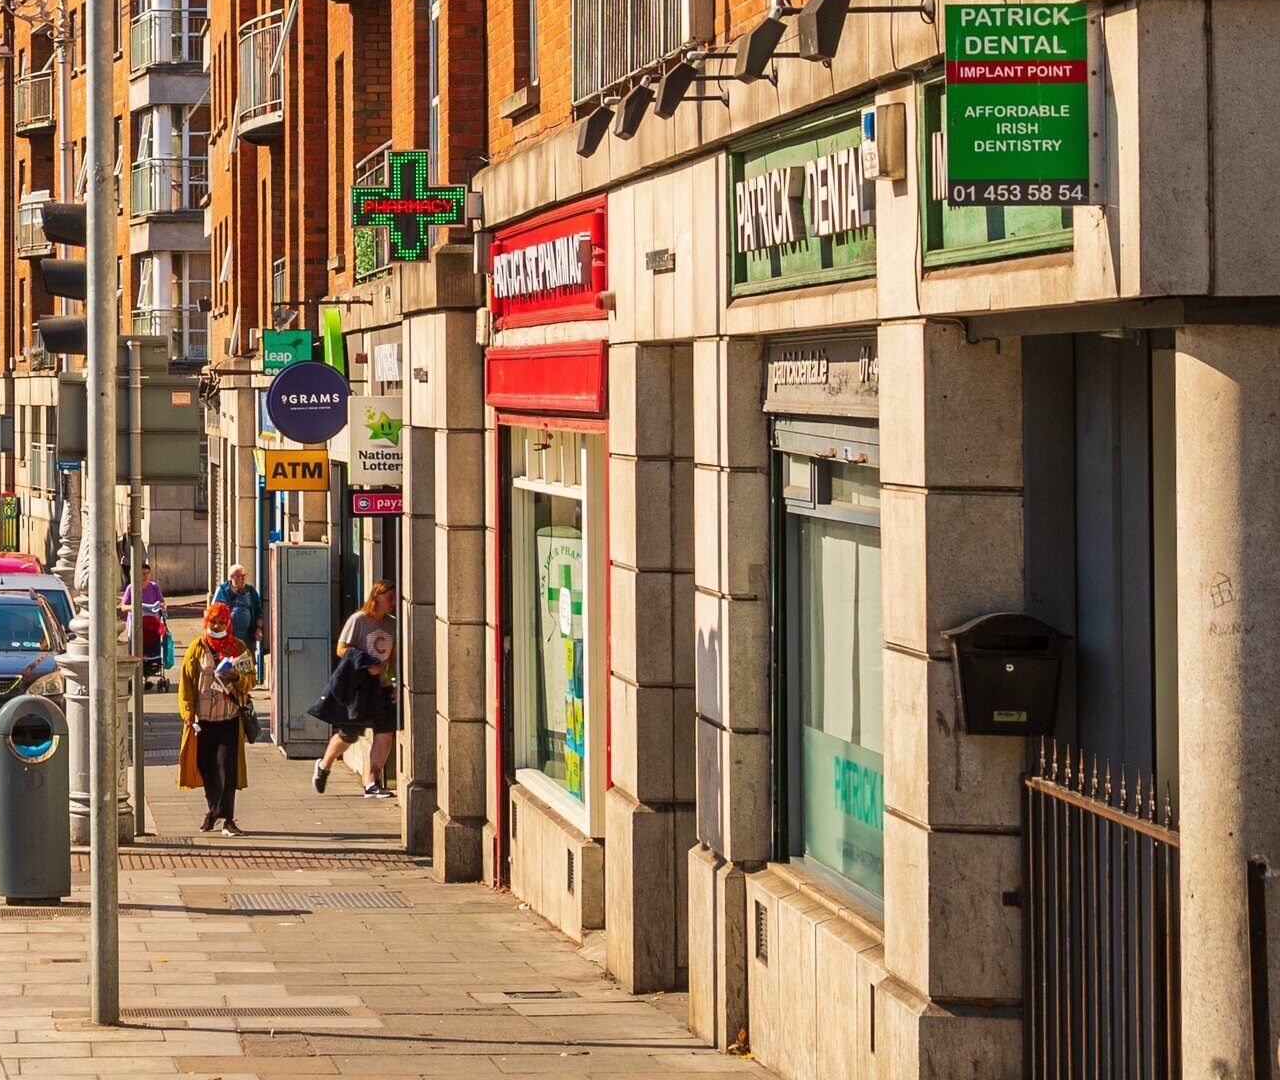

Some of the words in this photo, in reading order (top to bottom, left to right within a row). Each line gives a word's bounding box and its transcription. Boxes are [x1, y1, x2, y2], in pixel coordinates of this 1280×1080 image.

[960, 6, 1070, 27] PATRICK
[965, 35, 1067, 55] DENTAL
[959, 65, 1024, 78] IMPLANT
[1027, 65, 1073, 77] POINT
[964, 104, 1070, 118] AFFORDABLE
[996, 122, 1039, 135] IRISH
[974, 139, 1062, 152] DENTISTRY
[953, 185, 976, 202] 01
[984, 185, 1021, 201] 453
[1027, 184, 1052, 201] 58
[1058, 184, 1083, 201] 54
[364, 199, 454, 213] PHARMACY
[736, 166, 794, 253] PATRICK
[264, 349, 293, 365] Leap
[358, 449, 403, 461] Nation
[272, 461, 323, 479] ATM
[377, 499, 403, 510] payz
